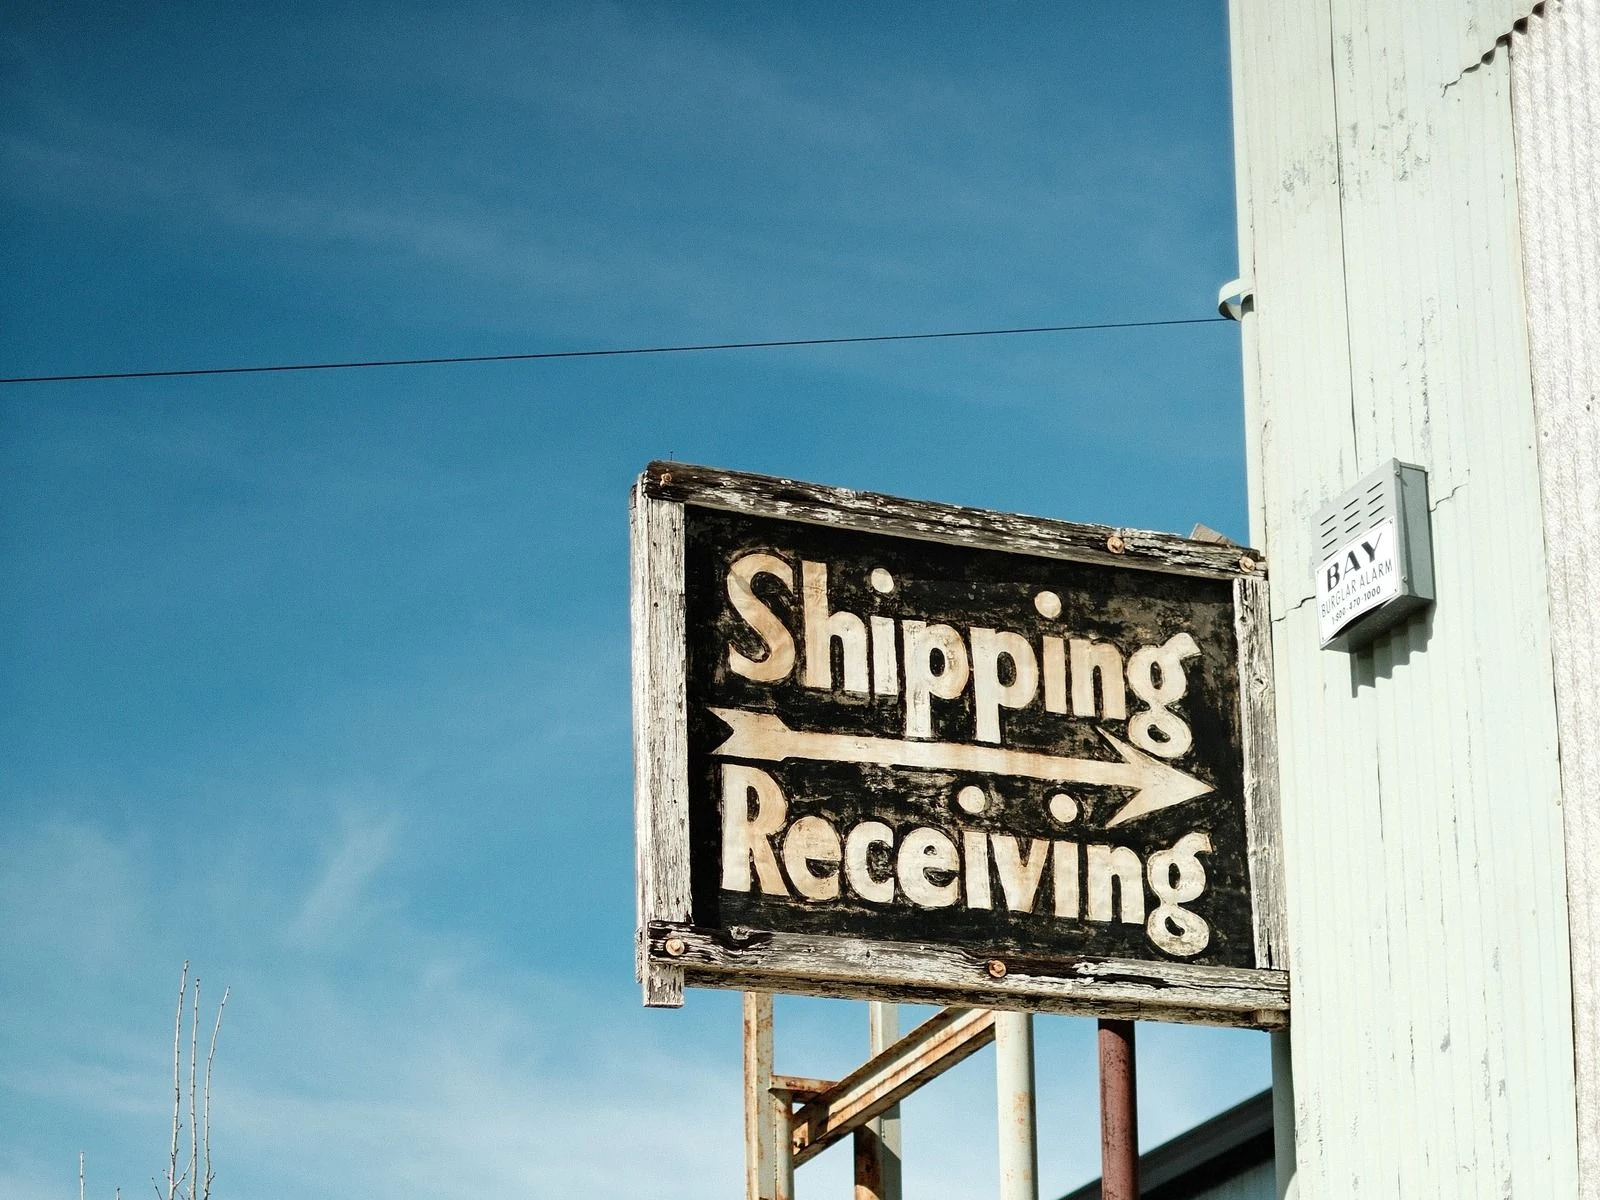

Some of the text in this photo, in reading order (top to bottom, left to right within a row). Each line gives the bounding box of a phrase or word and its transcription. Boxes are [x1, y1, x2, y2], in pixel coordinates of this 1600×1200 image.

[1321, 558, 1393, 618] BURGLAR ALARM
[1327, 532, 1382, 592] BAY
[727, 553, 1201, 758] Shipping
[721, 763, 1212, 957] Receiving
